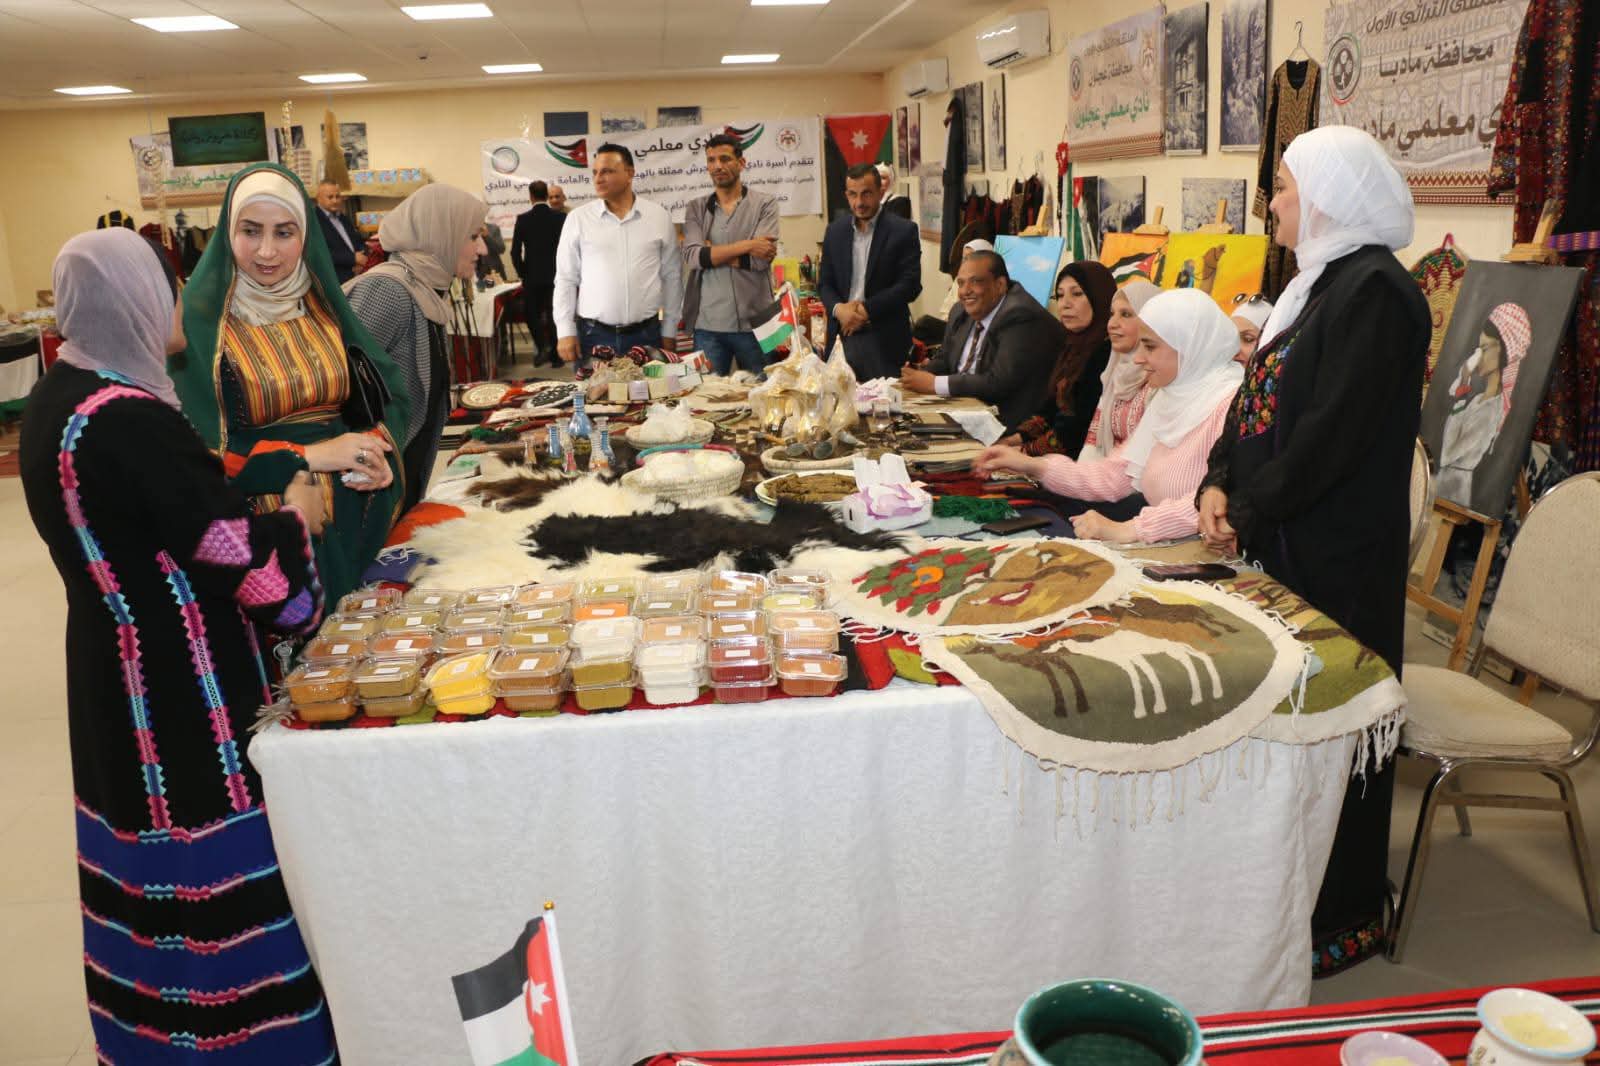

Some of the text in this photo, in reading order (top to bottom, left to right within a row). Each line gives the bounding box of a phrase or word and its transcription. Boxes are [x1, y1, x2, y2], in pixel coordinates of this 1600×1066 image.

[1366, 12, 1397, 33] الأول
[1400, 1, 1448, 31] التراثي
[1379, 38, 1494, 84] محافظة مادبا
[1396, 102, 1475, 157] معلمي
[634, 138, 684, 160] معلمي
[485, 180, 511, 193] النادي
